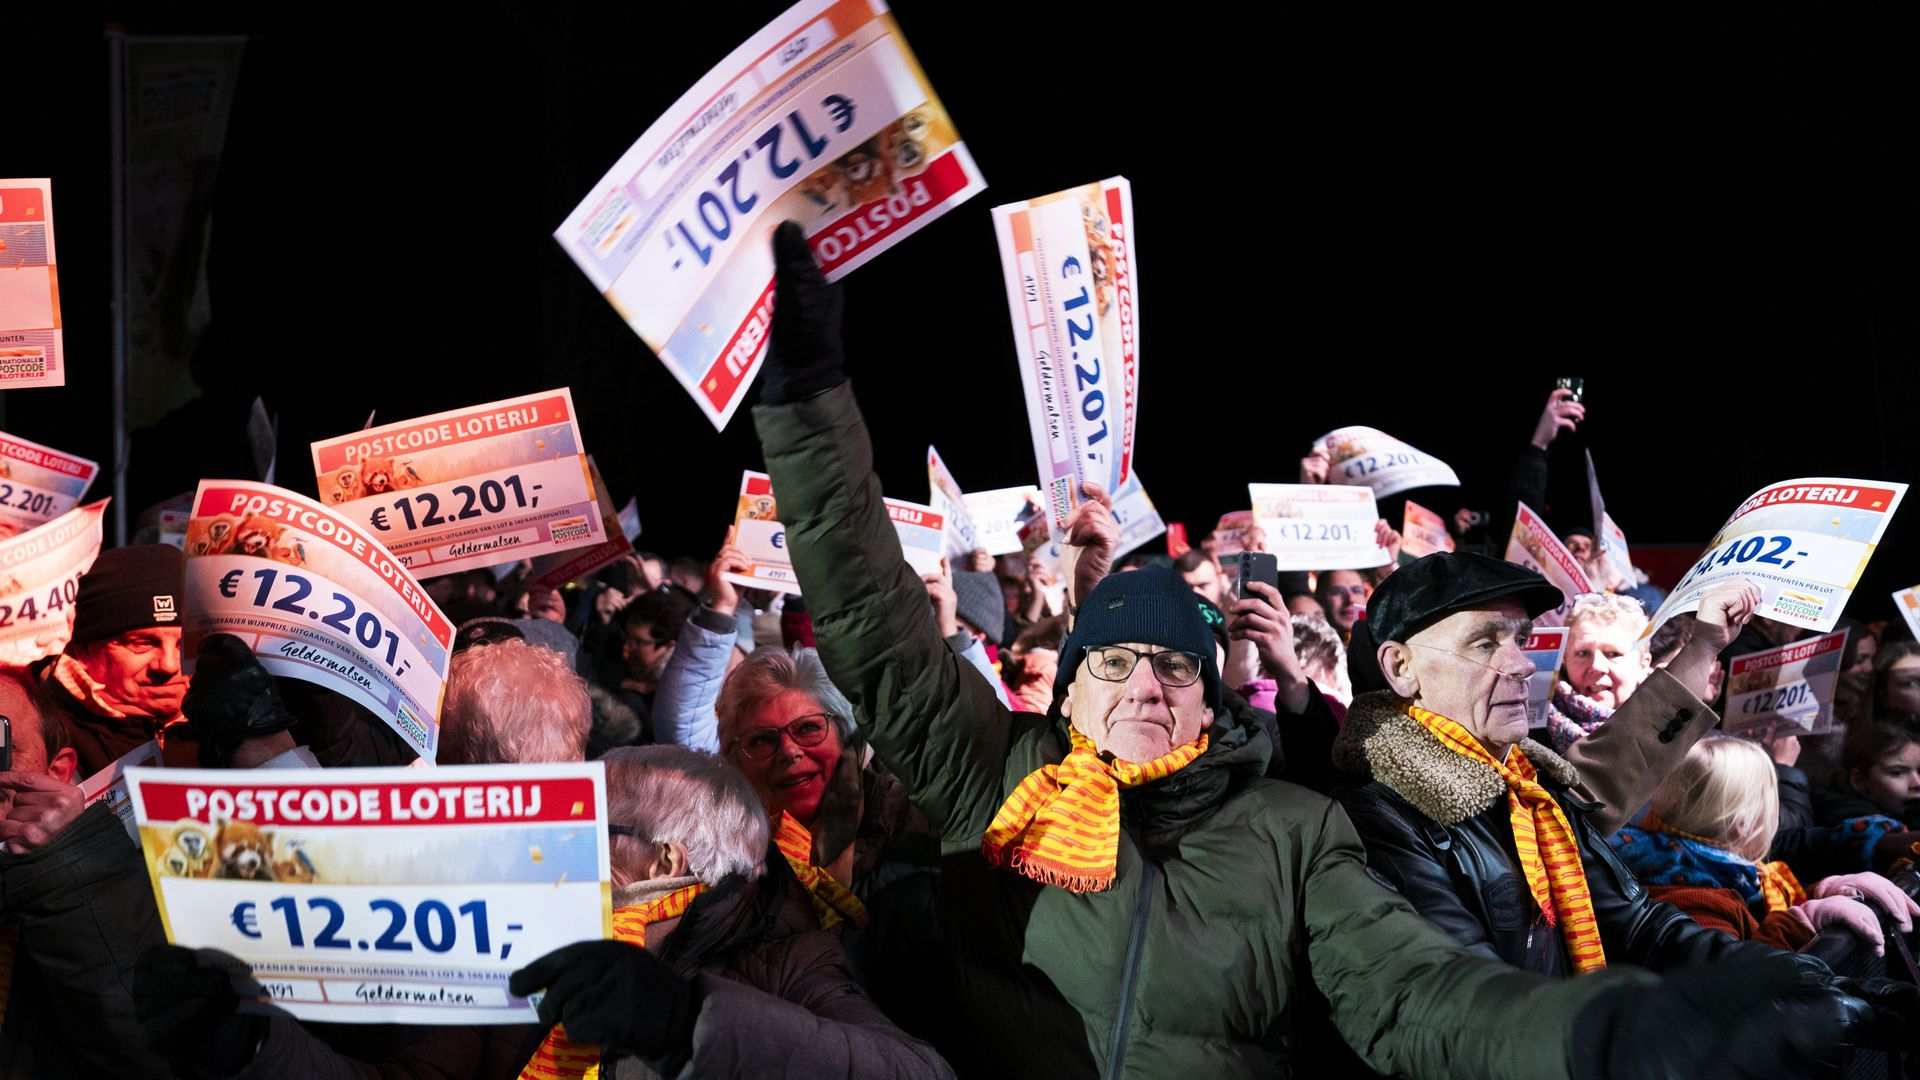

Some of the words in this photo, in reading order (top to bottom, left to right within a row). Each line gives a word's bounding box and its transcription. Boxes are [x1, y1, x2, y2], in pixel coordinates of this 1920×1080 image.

[816, 179, 932, 263] POSTCO
[3, 372, 40, 380] LOTERIJ
[344, 424, 452, 463] POSTCODE
[454, 405, 539, 438] LOTERIJ
[0, 441, 43, 465] TCODE
[1055, 480, 1066, 519] POSTCOD
[1766, 486, 1859, 504] LOTERIJ
[479, 525, 492, 533] VAN
[525, 509, 570, 522] KANJERPUNTEN
[553, 528, 590, 540] POSTCODE
[2, 540, 47, 565] CODE
[229, 493, 365, 556] POSTCODE
[369, 552, 434, 623] LOTERIJ
[449, 536, 522, 558] Geldermalsen
[1751, 571, 1805, 588] KANJERPUNTEN
[1805, 583, 1819, 591] PER
[1819, 586, 1834, 594] LOT
[1775, 601, 1822, 618] POSTCODE
[1778, 609, 1814, 621] LOTERIJ
[1783, 597, 1818, 609] NATIONALE
[280, 641, 373, 690] Geldermalsen
[290, 626, 335, 647] UITGAANDE
[336, 643, 351, 654] VAN
[356, 655, 369, 667] LOT
[384, 674, 421, 713] KANJERPUNTEN
[1744, 648, 1794, 672] POSTCODE
[397, 713, 427, 744] POSTCODE
[186, 789, 381, 823] POSTCODE
[390, 785, 542, 821] LOTERIJ
[355, 982, 475, 1004] Geldermalsen
